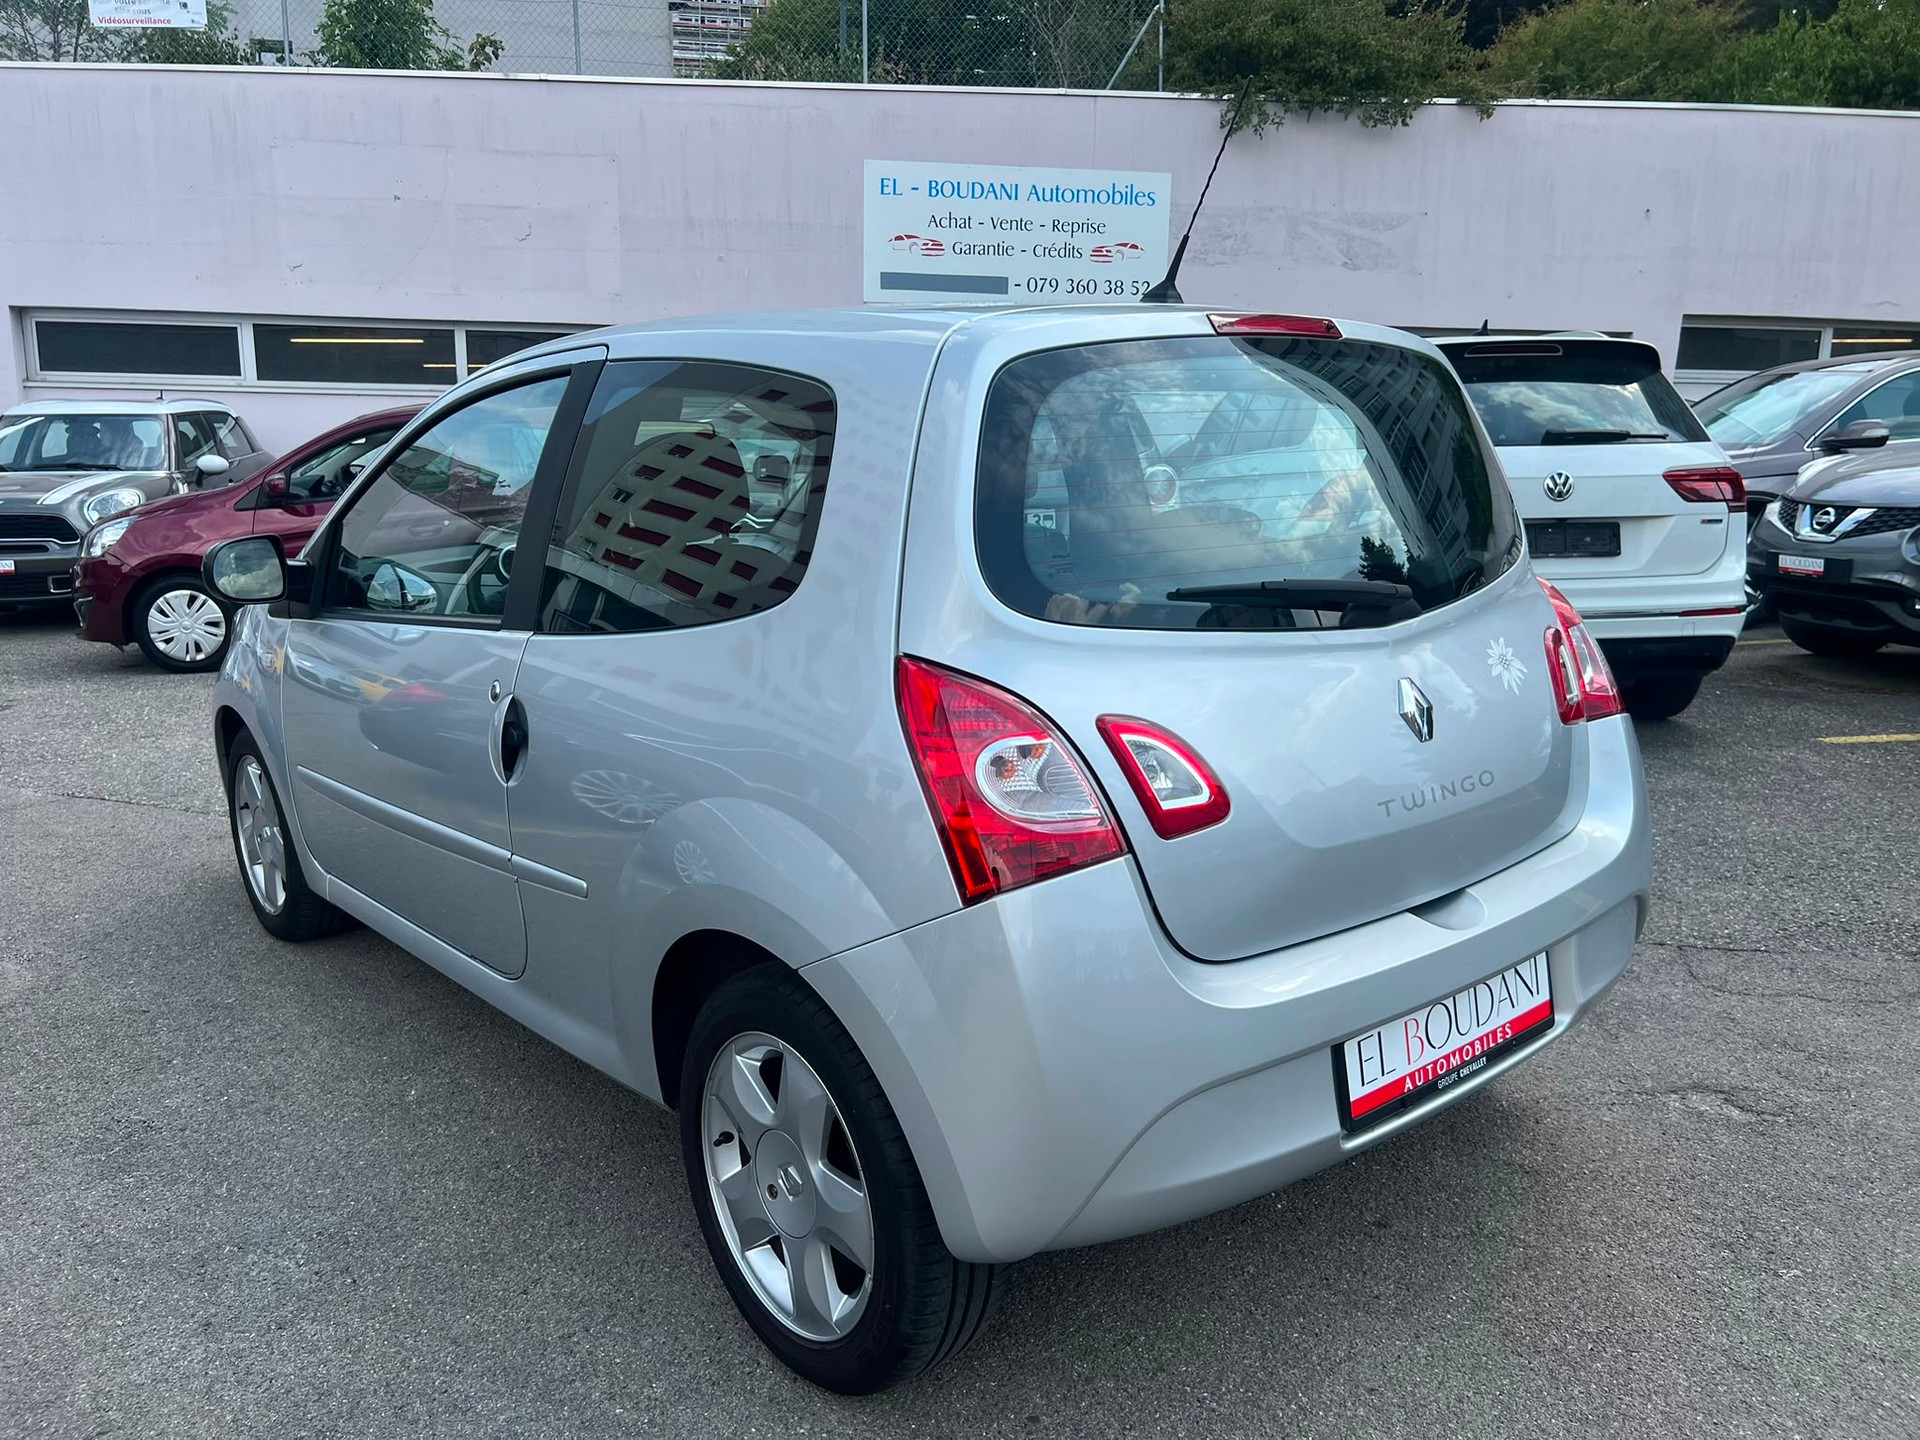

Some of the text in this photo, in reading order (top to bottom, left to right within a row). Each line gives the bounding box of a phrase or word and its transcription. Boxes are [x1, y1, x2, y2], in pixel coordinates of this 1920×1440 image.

[97, 16, 172, 25] Vidéosurveillance
[879, 177, 902, 196] EL
[928, 179, 1019, 201] BOUDANI
[1026, 183, 1156, 207] Automobiles
[927, 212, 972, 230] Achat
[990, 216, 1034, 232] Vente
[1052, 218, 1107, 238] Reprise
[952, 240, 1015, 257] Garantie
[1032, 242, 1083, 260] Crédits
[1026, 276, 1059, 294] 079
[1065, 278, 1098, 296] 360
[1103, 279, 1124, 296] 38
[1131, 280, 1151, 297] 52
[1377, 770, 1495, 818] TWINGO
[1357, 956, 1541, 1087] EL BOUDANI
[1404, 1023, 1512, 1092] AUTOMOBILES
[1437, 1056, 1487, 1089] GROUPE CHEVALLEY
